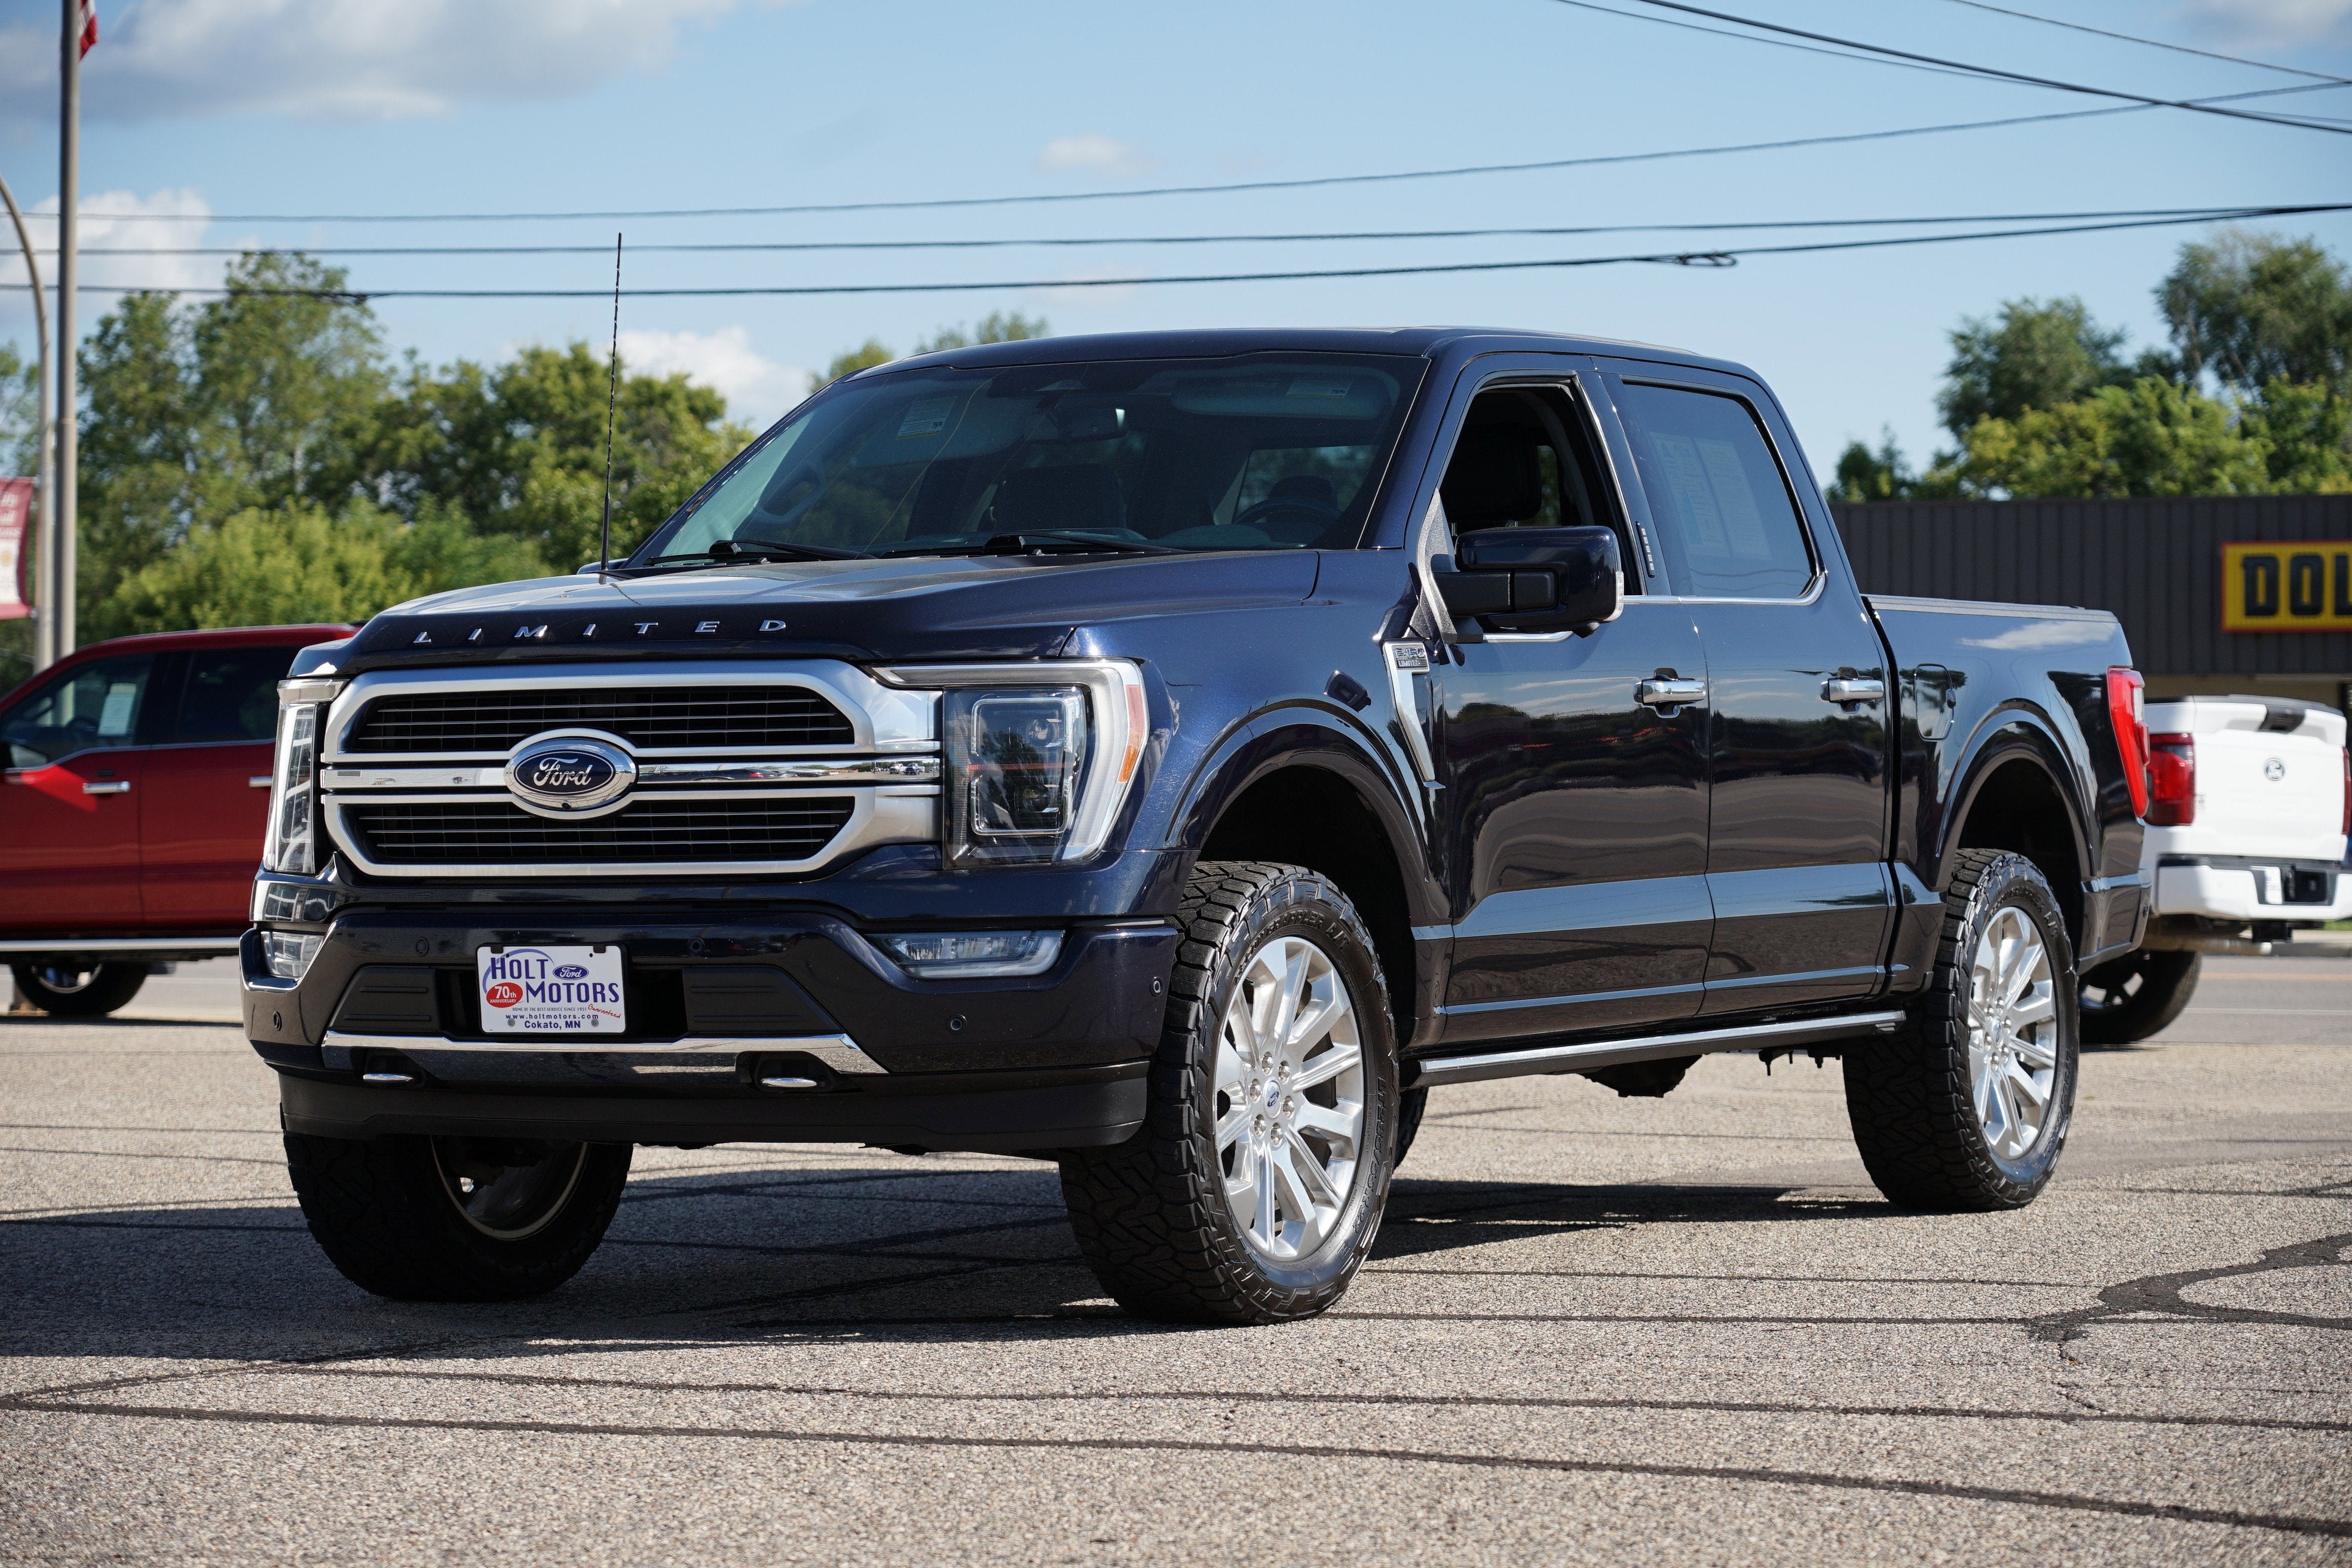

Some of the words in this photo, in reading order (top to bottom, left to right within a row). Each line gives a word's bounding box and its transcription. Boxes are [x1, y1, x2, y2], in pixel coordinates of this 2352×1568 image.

[413, 619, 786, 644] LIMITED
[1395, 648, 1425, 659] F-150
[533, 757, 593, 786] Ford
[490, 957, 549, 979] HOLT
[559, 966, 583, 978] Ford
[494, 985, 516, 999] 70th
[525, 981, 619, 1003] MOTORS
[587, 1003, 622, 1019] Guaranteed
[524, 1020, 562, 1030] Cokato,
